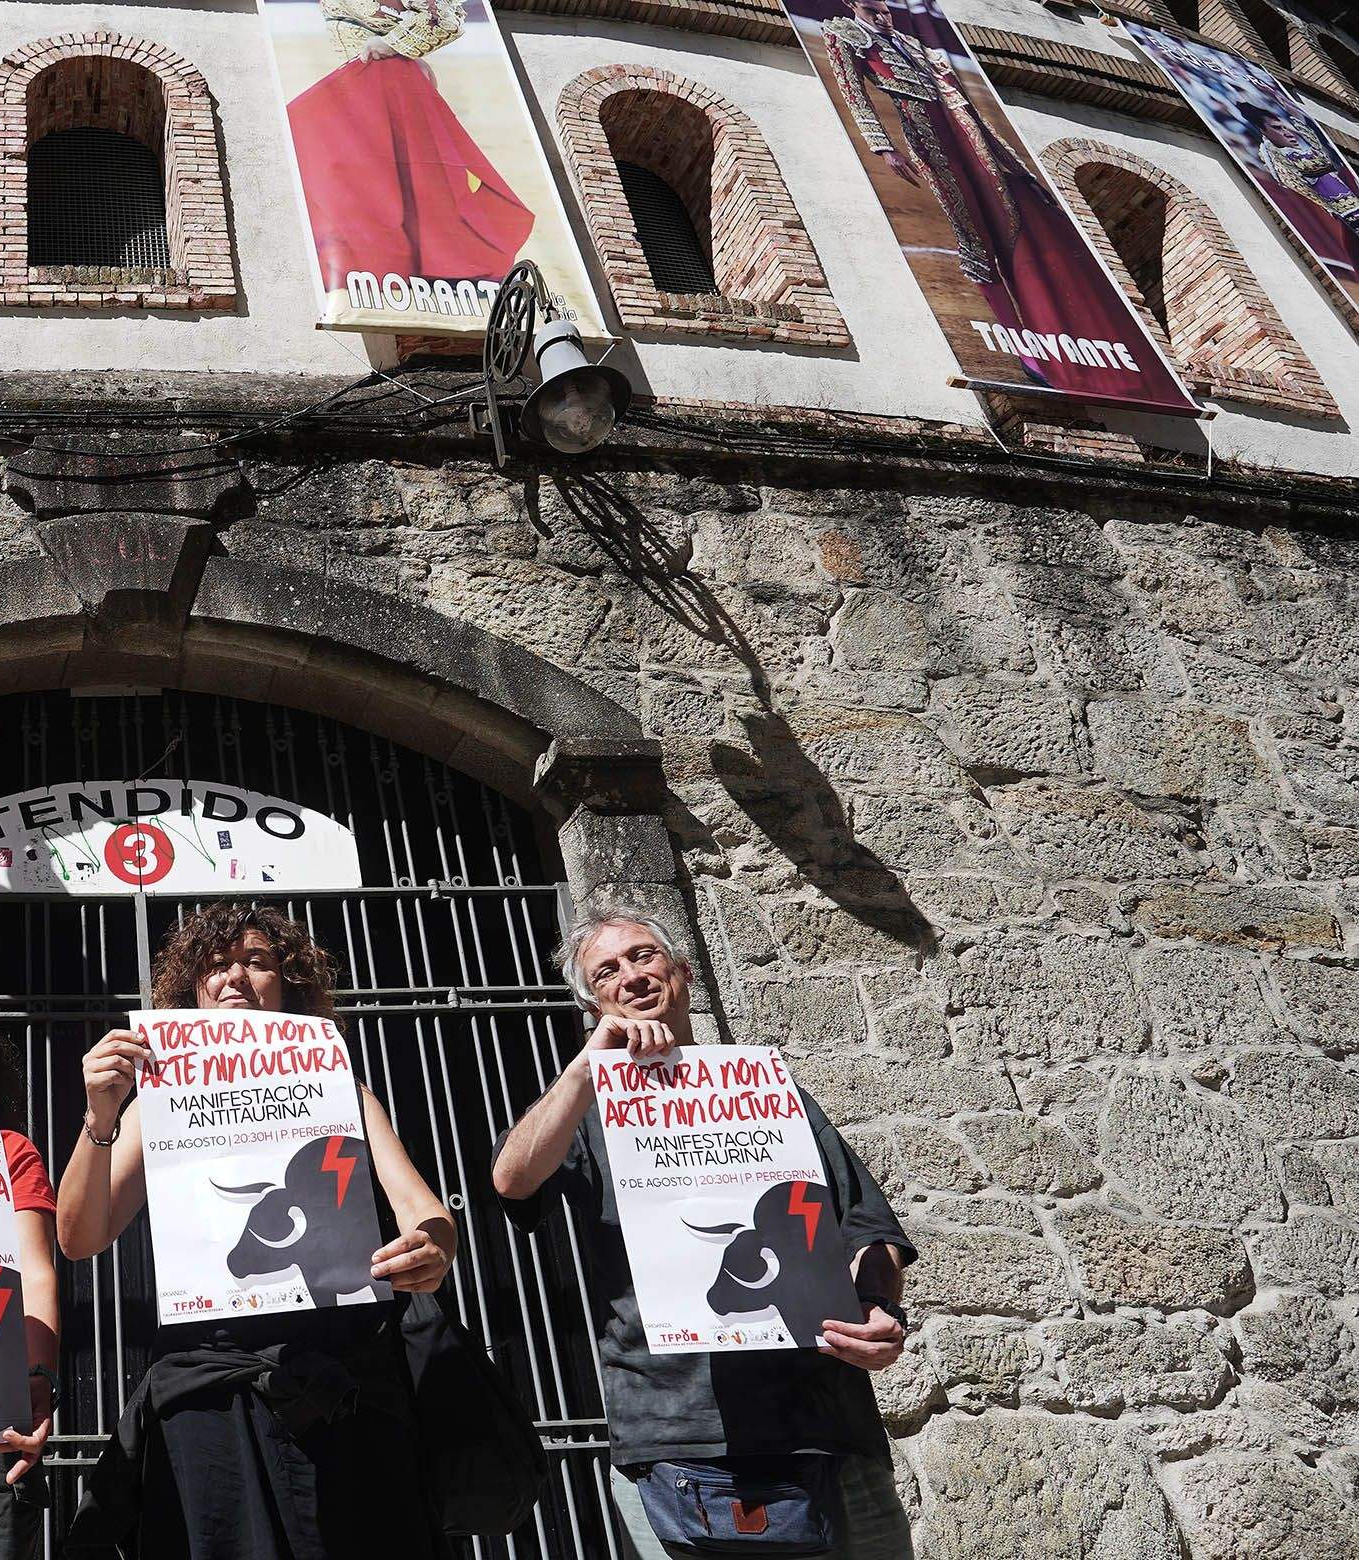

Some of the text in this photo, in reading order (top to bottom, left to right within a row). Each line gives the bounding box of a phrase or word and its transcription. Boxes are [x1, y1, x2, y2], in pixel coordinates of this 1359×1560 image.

[346, 271, 502, 317] MORANT
[970, 320, 1141, 373] TALAVANTE
[122, 831, 157, 876] 3
[138, 1024, 150, 1047] A
[152, 1019, 256, 1050] TORTURA
[321, 1019, 334, 1039] É
[140, 1052, 198, 1088] ARTE
[250, 1045, 348, 1077] CULTURA
[597, 1064, 613, 1093] A
[612, 1059, 714, 1092] TORTURA
[769, 1050, 786, 1085] É
[170, 1080, 323, 1113] MANIFESTACIÓN
[605, 1095, 657, 1128] ARTE
[708, 1090, 804, 1122] CULTURA
[188, 1102, 311, 1129] ANTITAURINA
[149, 1123, 357, 1152] 9 DE AGOSTO 20:30H P. PEREGRINA
[635, 1126, 784, 1152] MANIFESTACIÓN
[654, 1147, 773, 1168] ANTITAURINA
[620, 1178, 627, 1189] 9
[630, 1178, 645, 1189] DE
[646, 1176, 692, 1188] AGOSTO
[745, 1172, 755, 1183] P.
[756, 1170, 819, 1182] PEREGRINA
